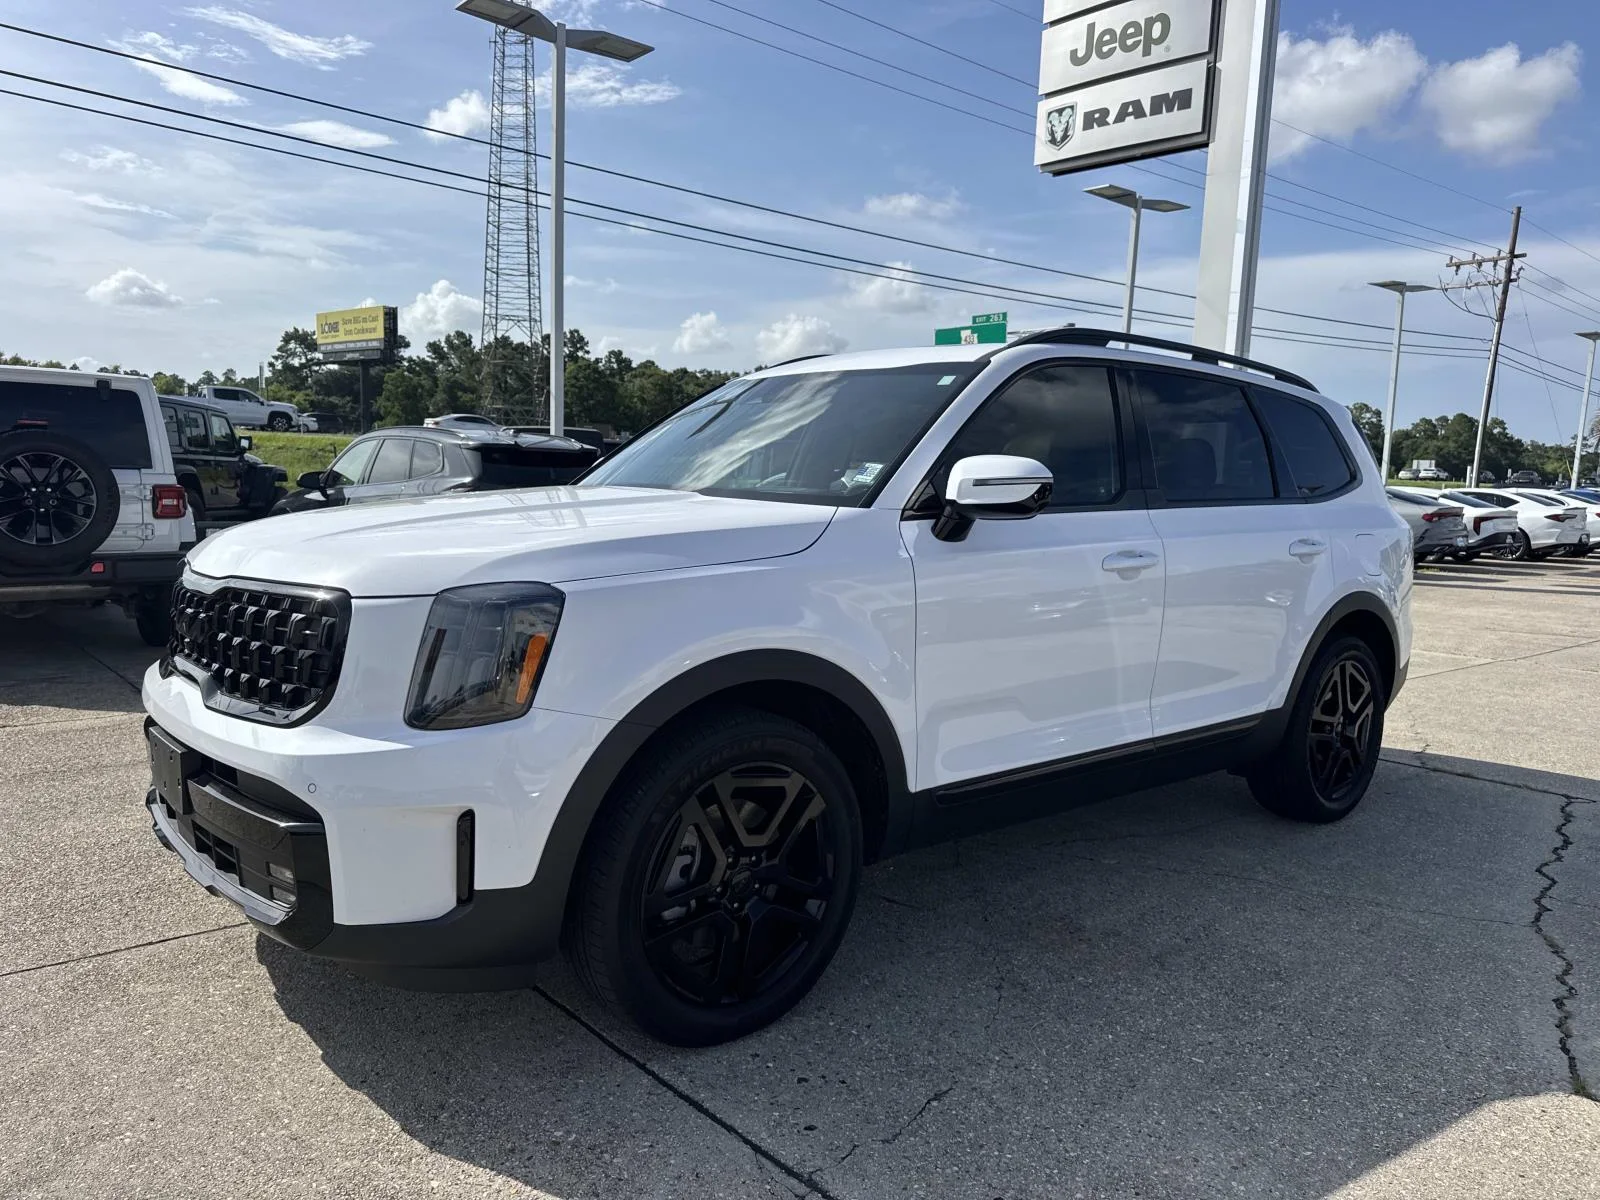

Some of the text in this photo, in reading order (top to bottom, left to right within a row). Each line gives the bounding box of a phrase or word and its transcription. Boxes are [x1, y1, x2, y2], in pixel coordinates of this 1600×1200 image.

[1069, 12, 1171, 67] Jeep
[1082, 87, 1193, 132] RAM
[989, 314, 1003, 322] 263
